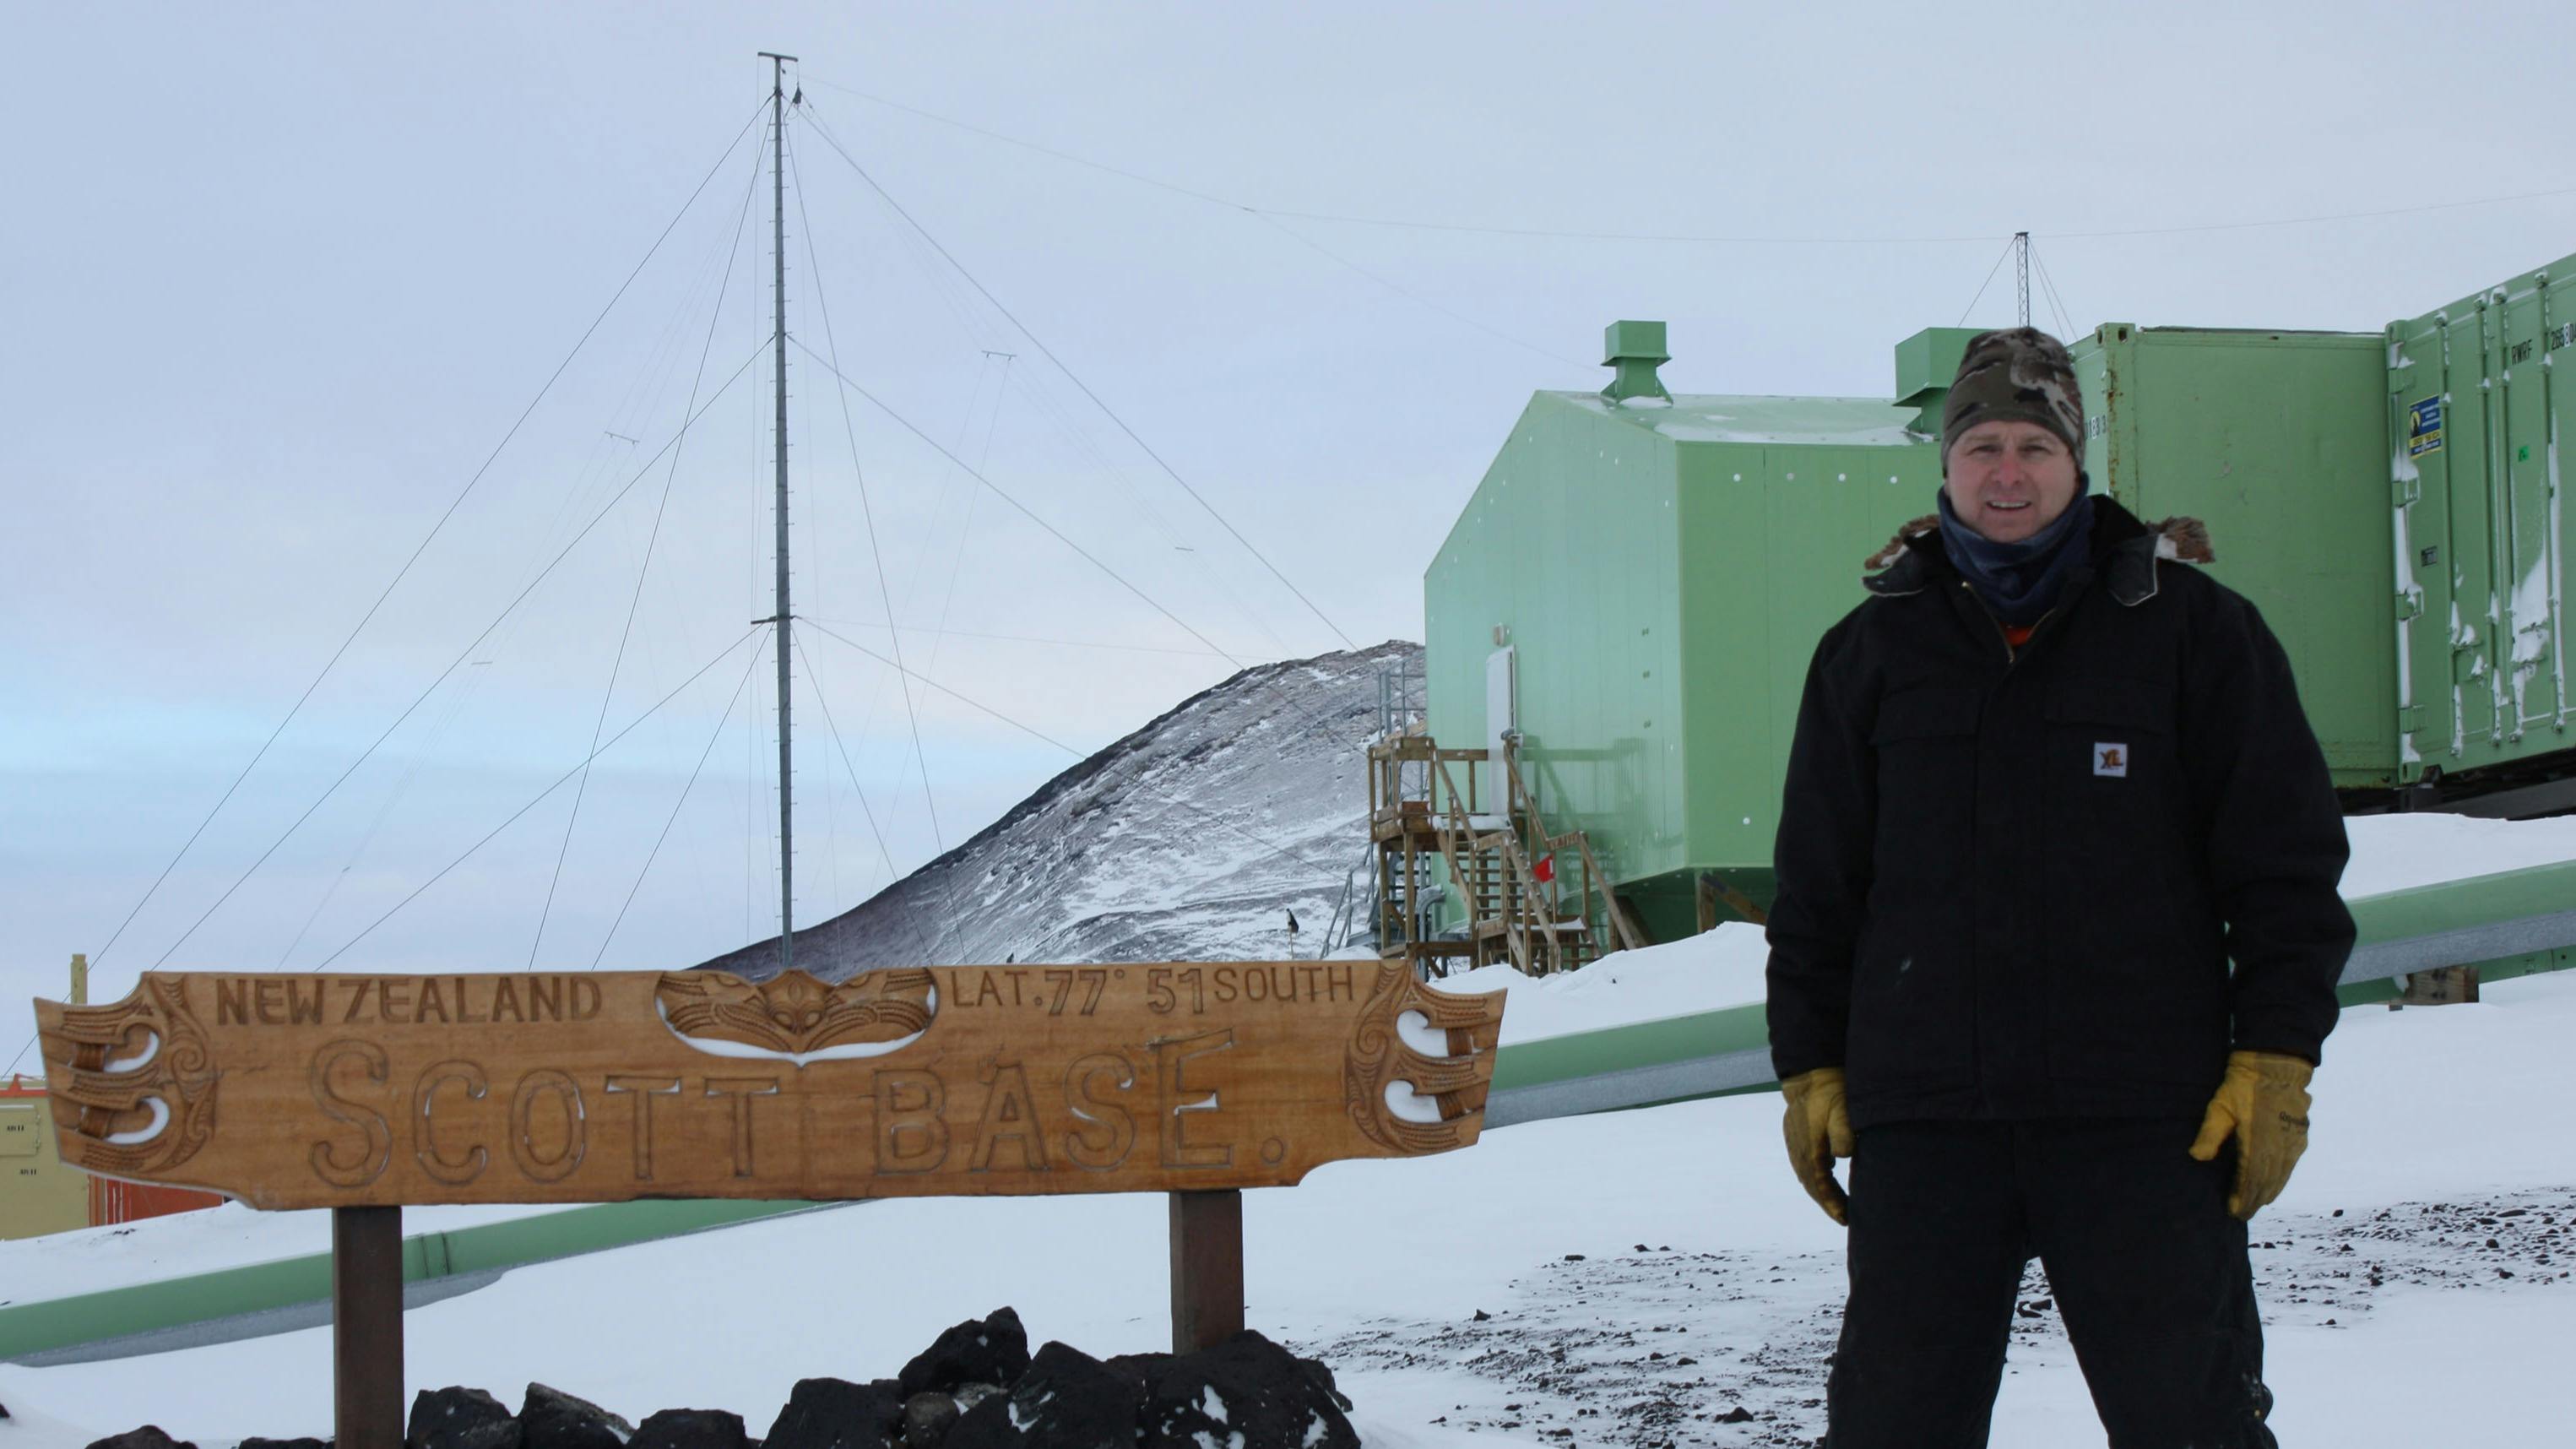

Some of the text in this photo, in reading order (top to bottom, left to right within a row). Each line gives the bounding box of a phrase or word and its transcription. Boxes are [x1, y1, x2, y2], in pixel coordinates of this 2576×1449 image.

[216, 976, 602, 1026] NEW ZEALAND
[1147, 968, 1205, 1015] 51
[1212, 965, 1354, 1003] SOUTH
[307, 1027, 1286, 1189] SCOTT BASE.
